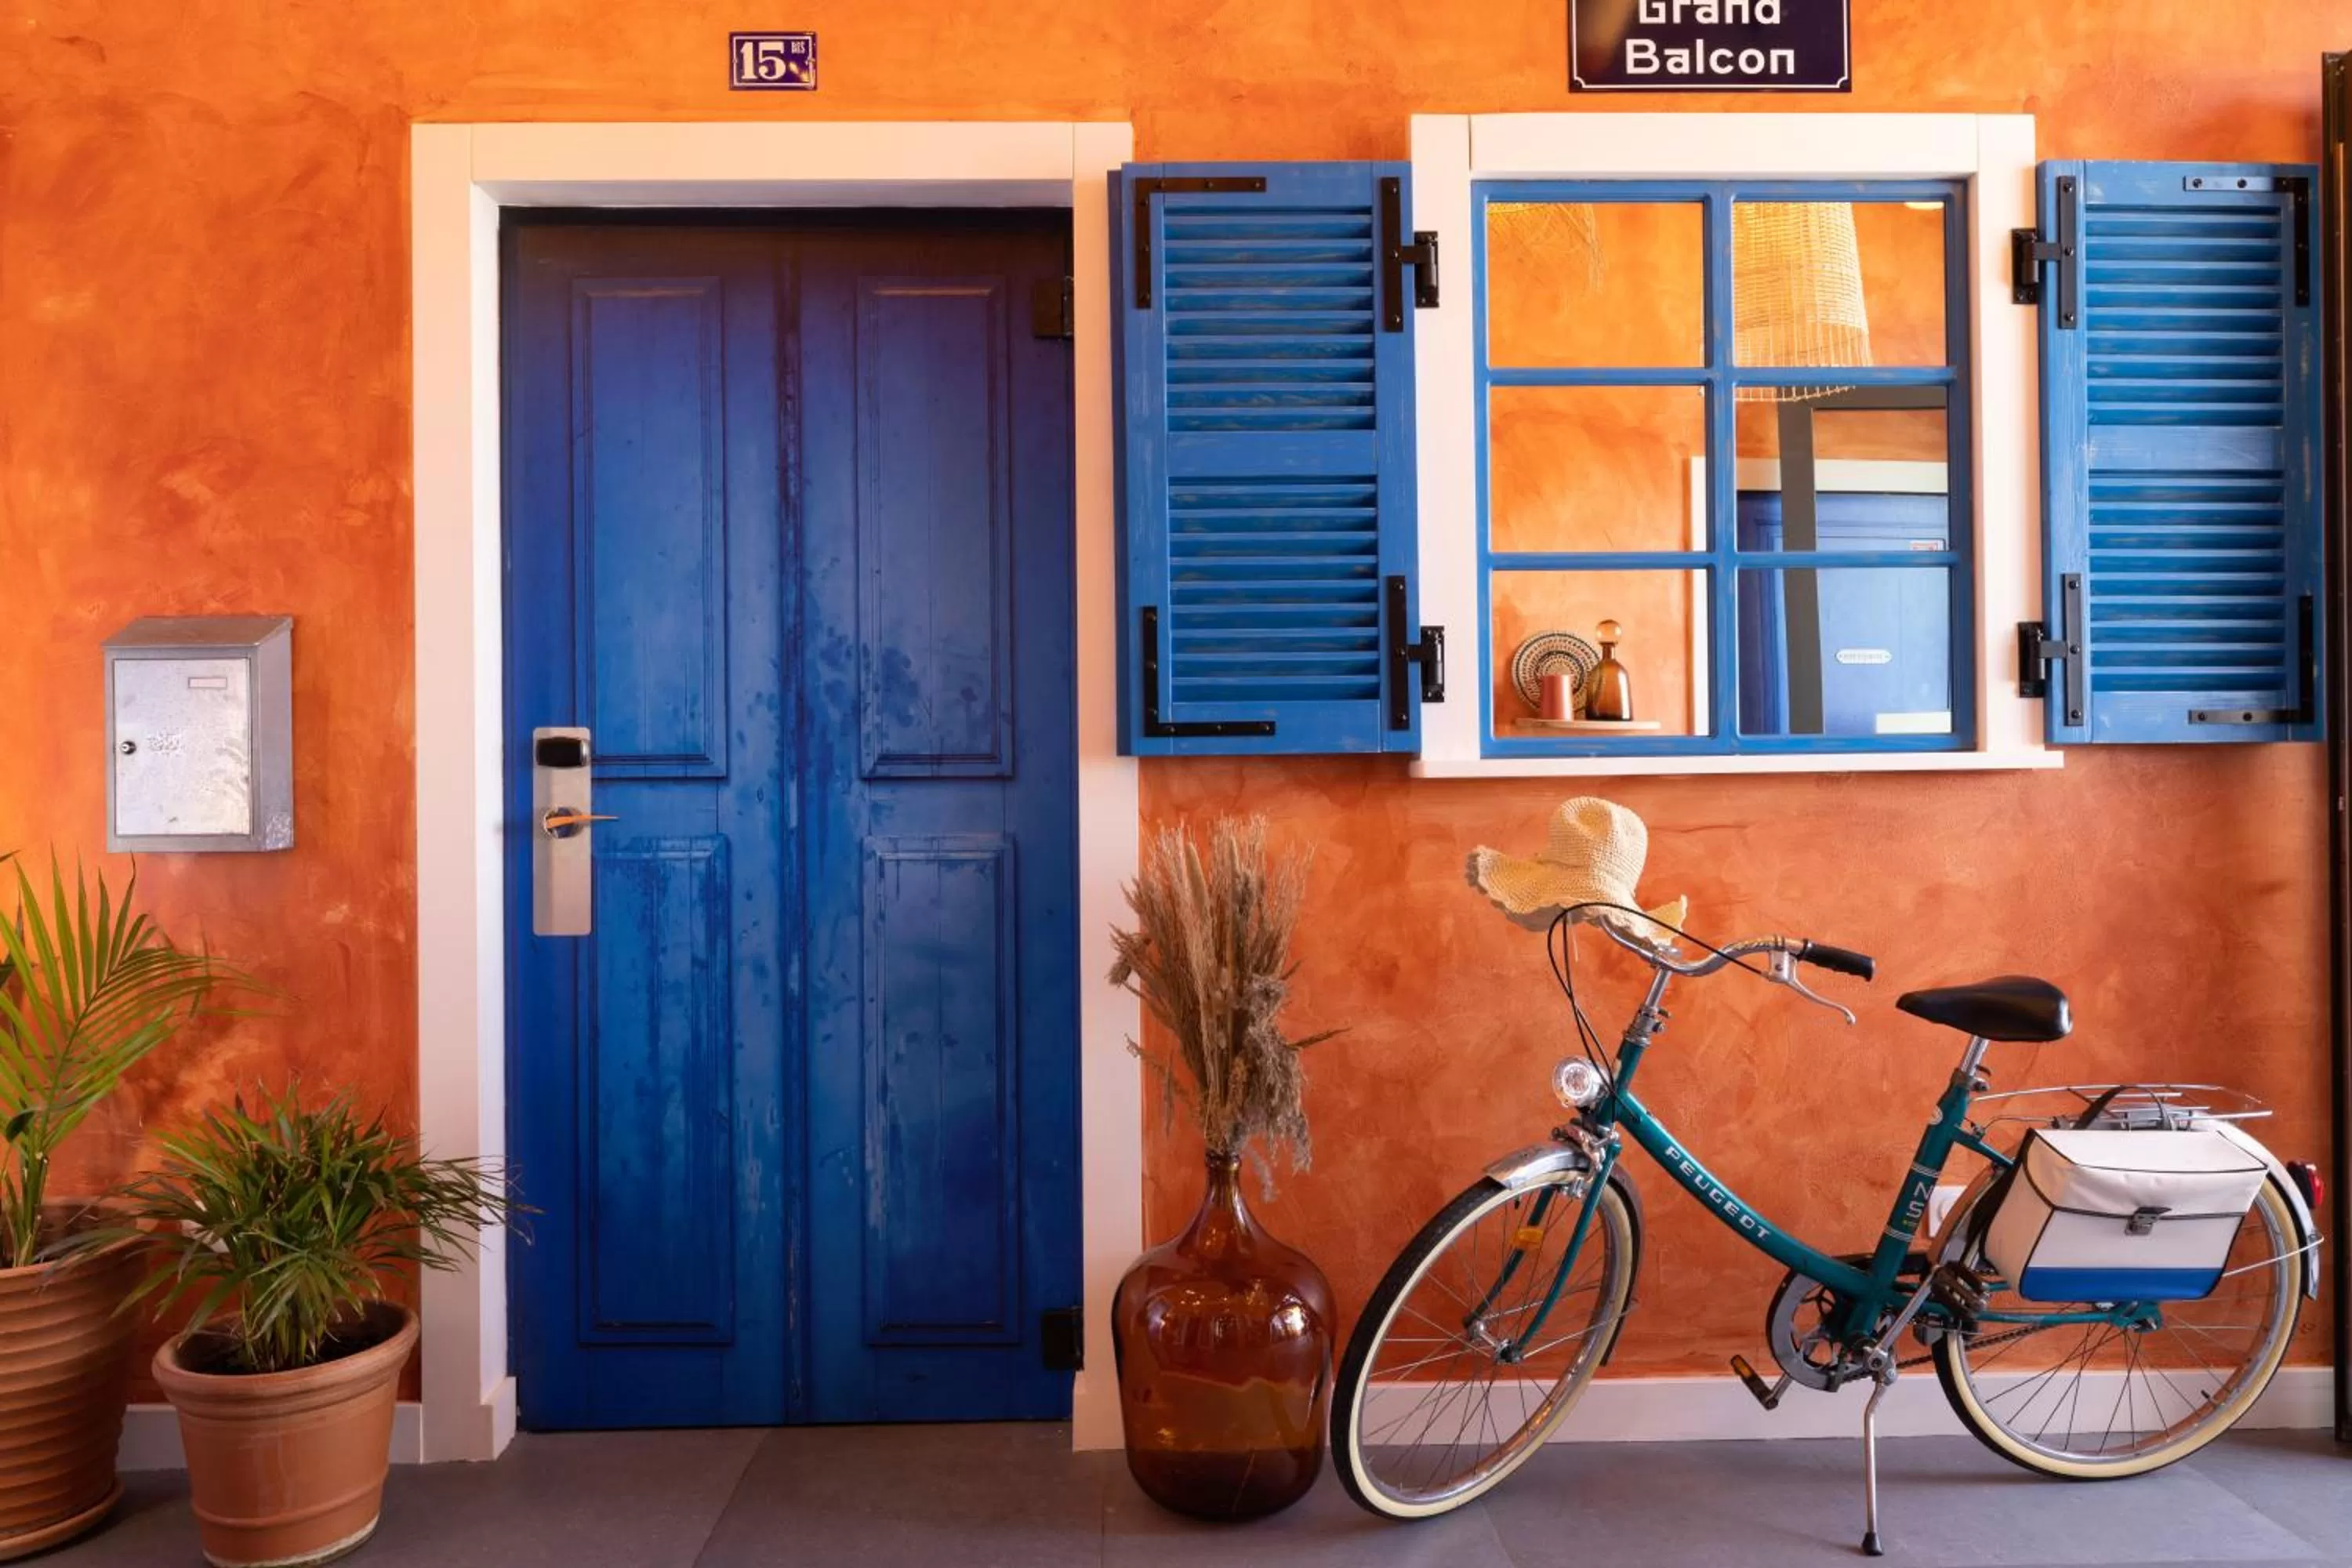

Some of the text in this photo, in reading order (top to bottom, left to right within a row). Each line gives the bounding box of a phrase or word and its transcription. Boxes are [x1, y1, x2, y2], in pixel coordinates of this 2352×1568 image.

[1639, 0, 1780, 24] Grand
[740, 41, 786, 80] 15
[1625, 38, 1795, 74] Balcon
[1665, 1145, 1770, 1238] PEUGEOT
